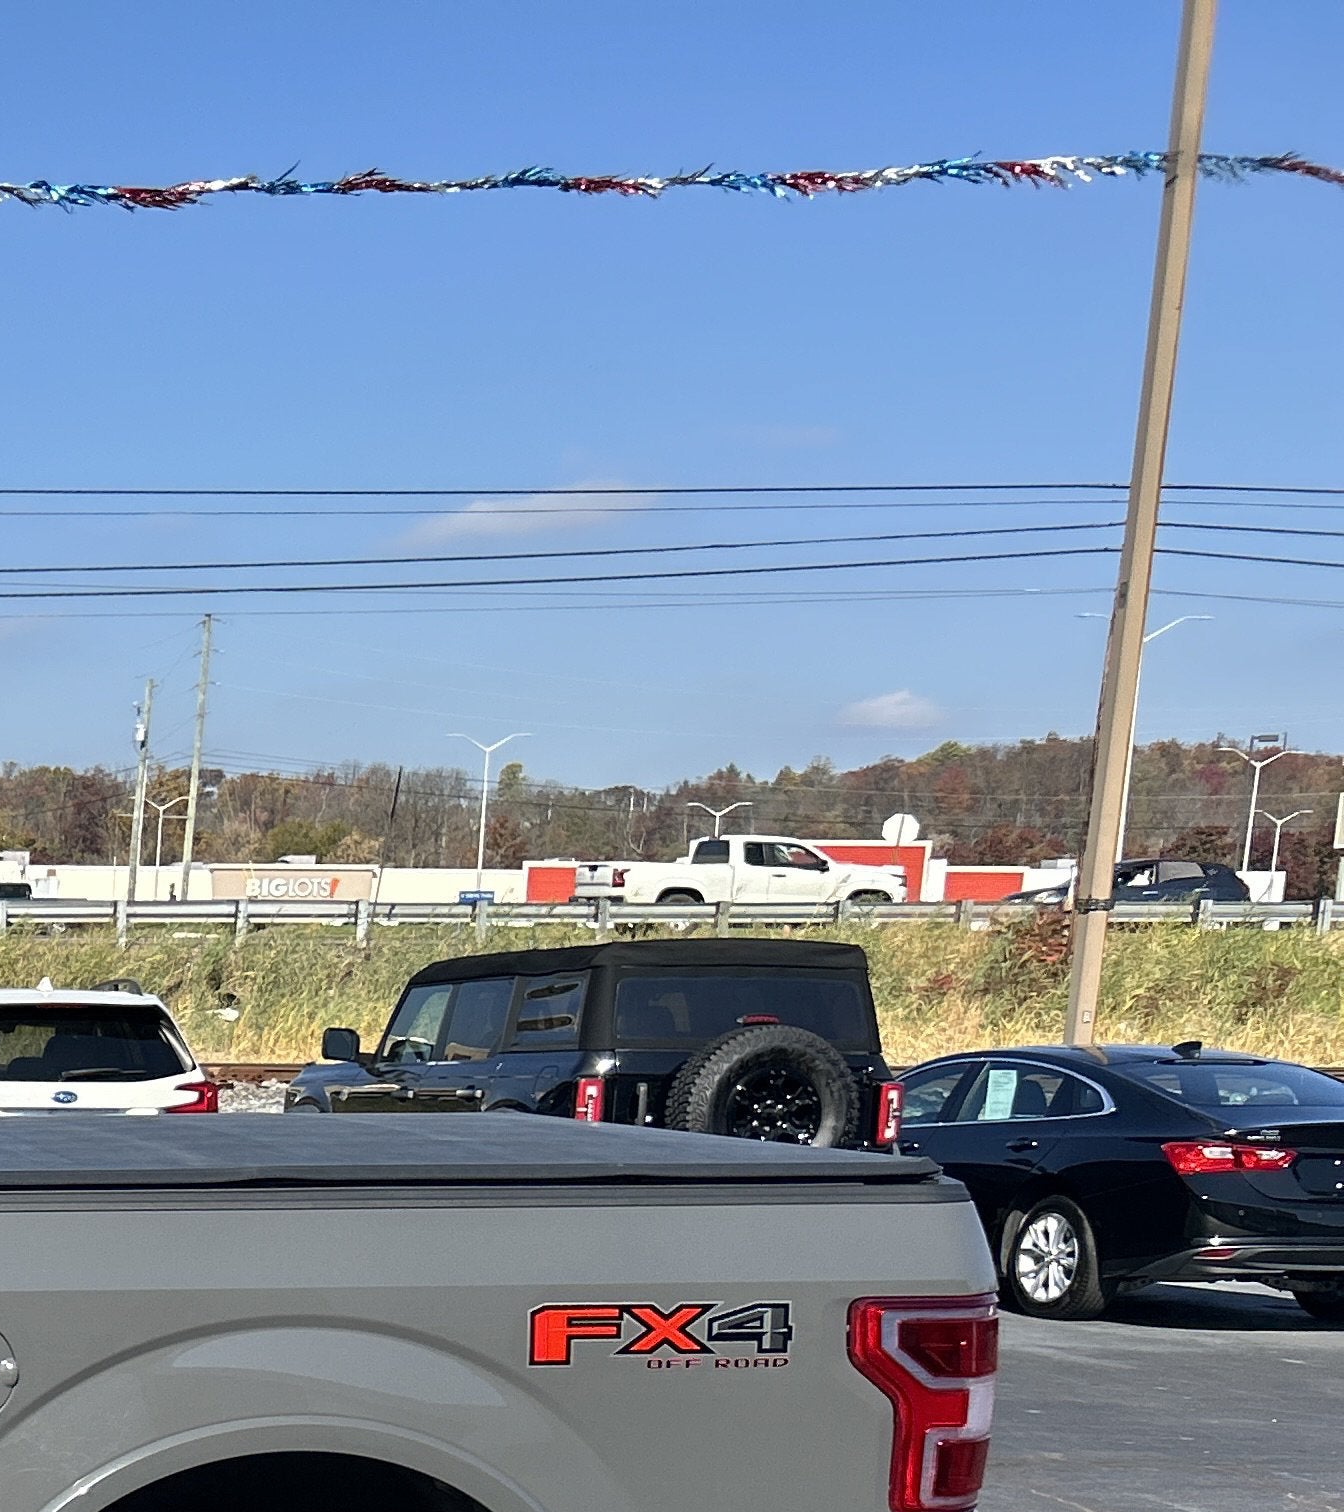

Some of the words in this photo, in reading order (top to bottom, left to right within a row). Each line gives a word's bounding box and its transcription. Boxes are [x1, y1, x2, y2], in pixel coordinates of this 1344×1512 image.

[528, 1300, 793, 1366] FX4
[646, 1357, 702, 1369] OFF
[714, 1357, 790, 1369] ROAD
